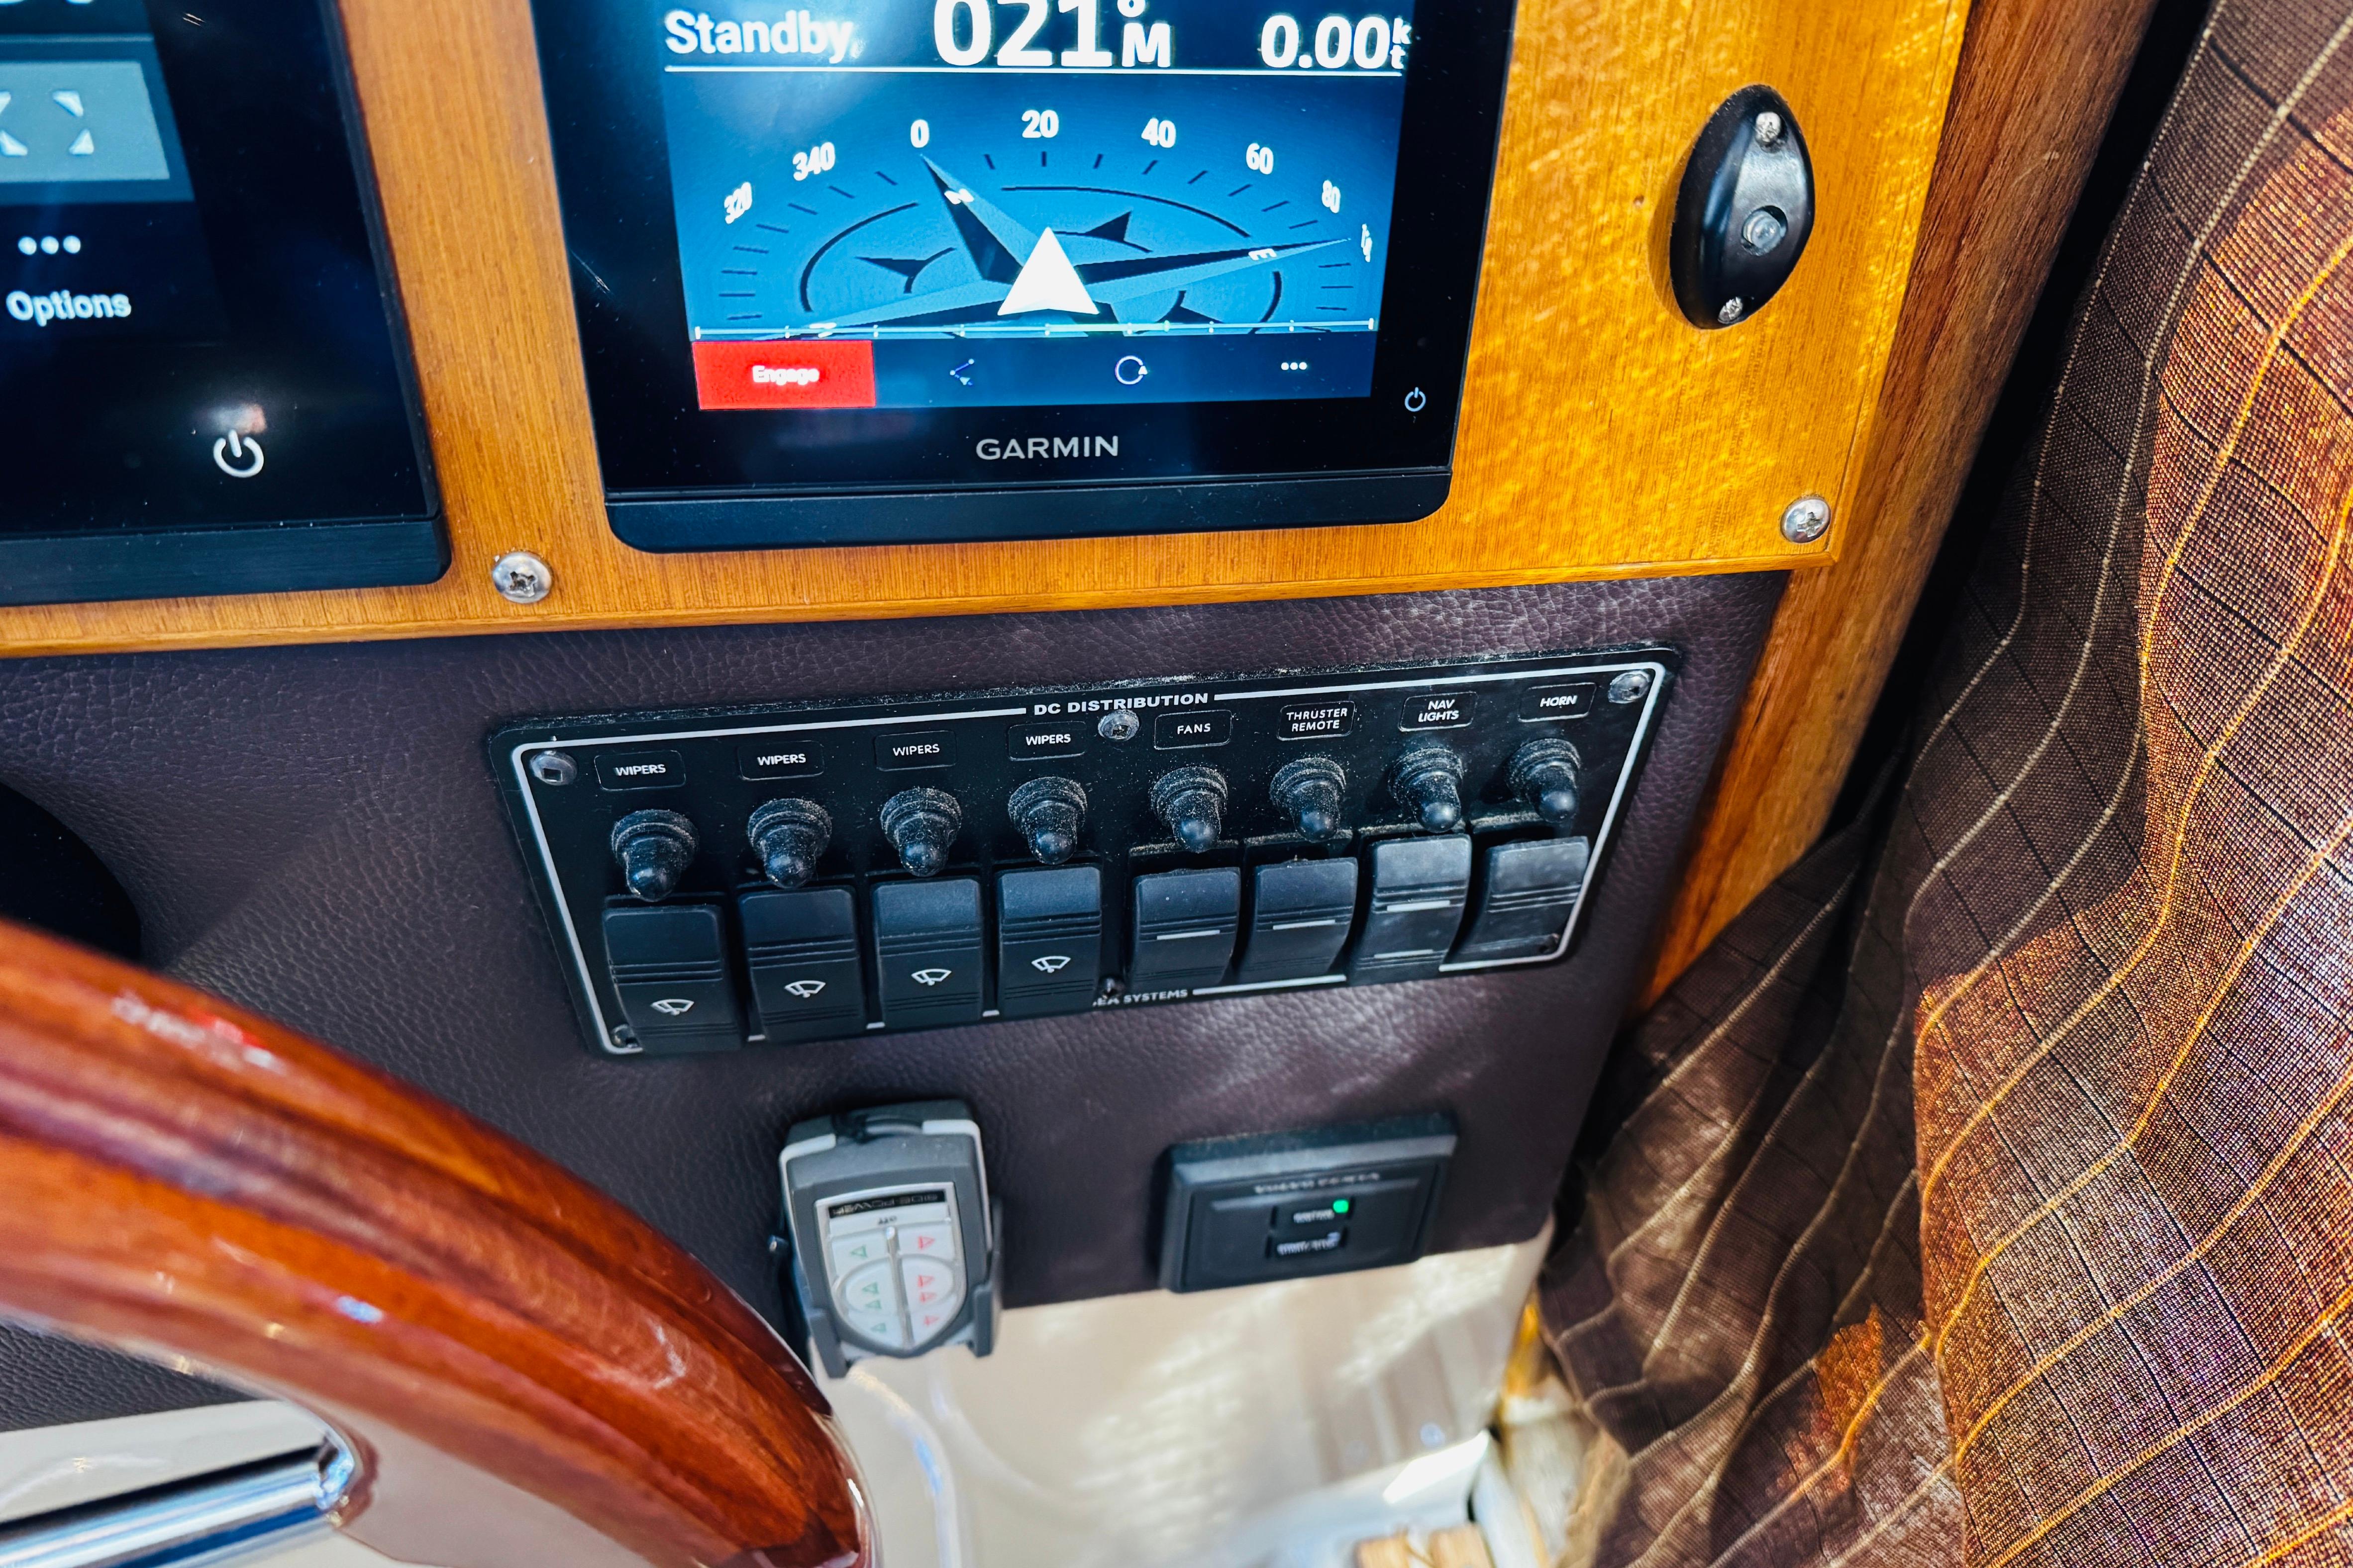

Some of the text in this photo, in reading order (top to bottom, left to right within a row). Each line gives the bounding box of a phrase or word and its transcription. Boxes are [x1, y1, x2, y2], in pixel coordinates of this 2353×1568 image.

[1022, 110, 1058, 138] 20
[911, 119, 929, 148] 0
[1141, 118, 1176, 148] 40
[793, 142, 835, 181] 340
[1246, 143, 1274, 175] 60
[1322, 180, 1340, 213] 80
[7, 290, 131, 326] Options
[752, 365, 820, 386] Engage
[976, 435, 1119, 461] GARMIN
[1034, 692, 1208, 715] DC DISTRIBUTION
[1428, 699, 1455, 710] NAV
[1539, 695, 1578, 707] HORN
[1286, 708, 1348, 721] THRUSTER
[1418, 710, 1460, 722] LIGHTS
[1177, 723, 1211, 734] FANS
[1291, 720, 1340, 732] REMOTE
[1025, 733, 1071, 746] WIPERS
[893, 744, 940, 756] WIPERS
[757, 753, 806, 766] WIPERS
[614, 764, 666, 776] WIPERS
[1124, 989, 1188, 1004] SYSTEMS
